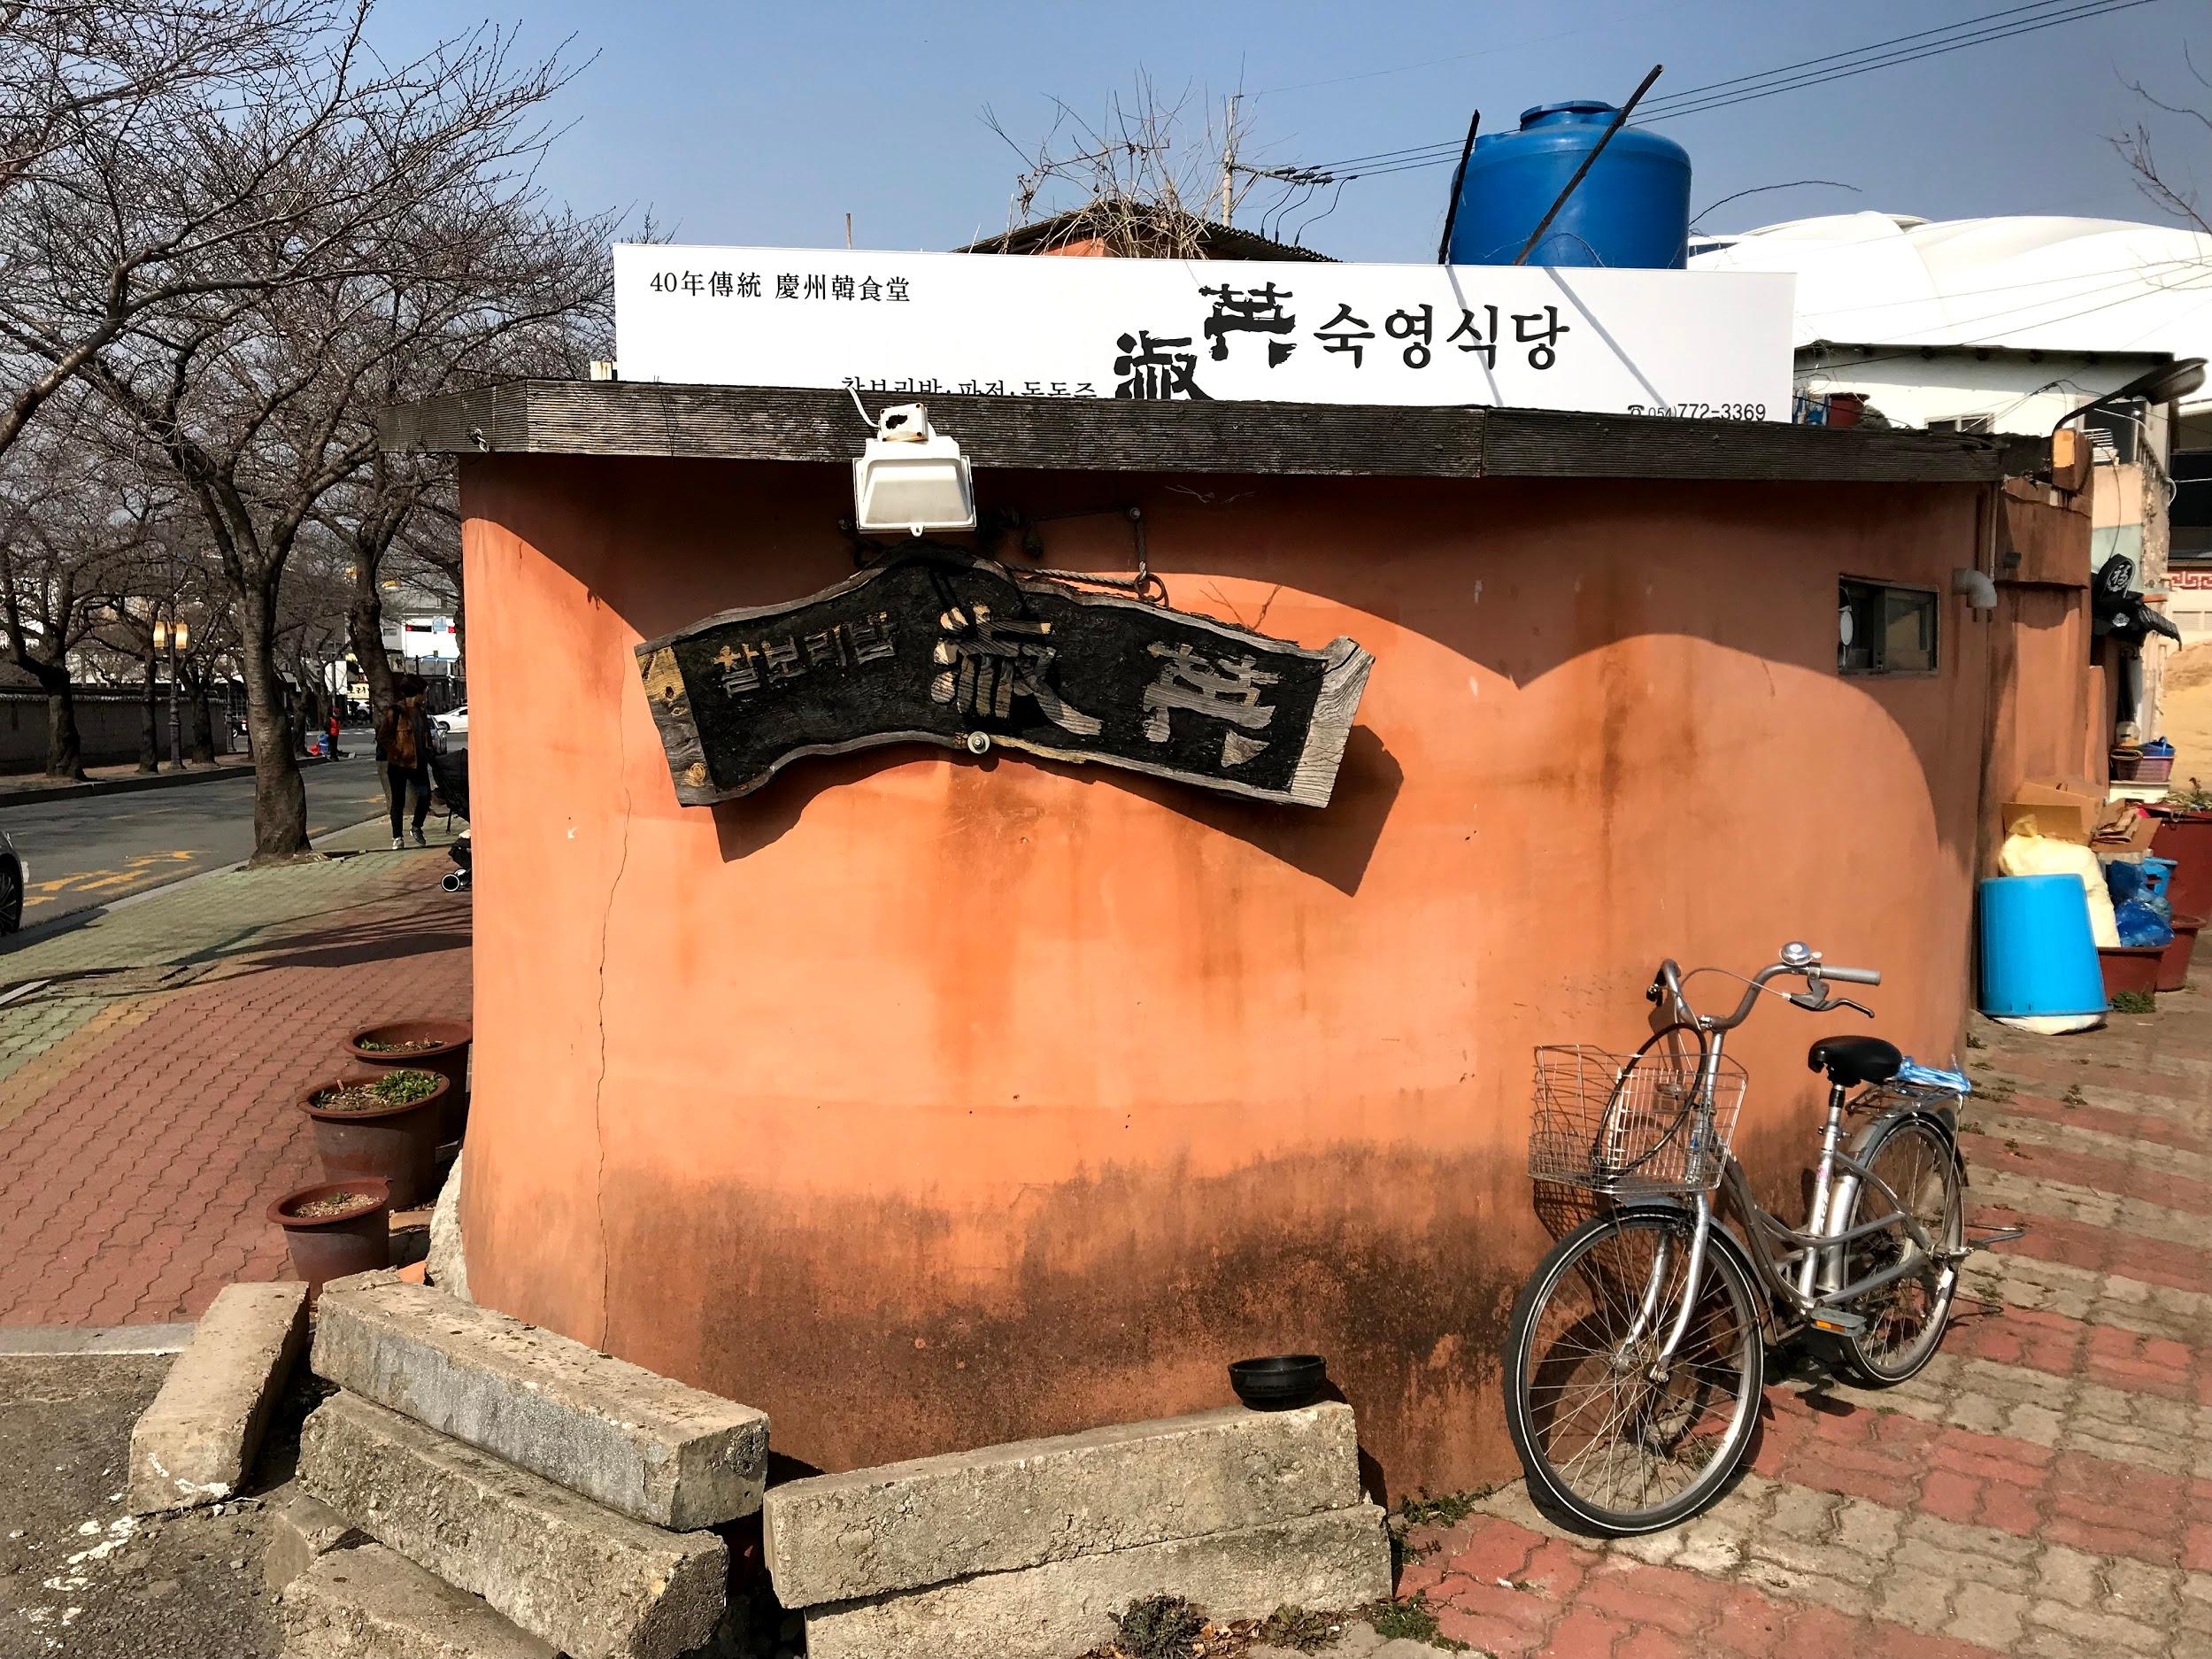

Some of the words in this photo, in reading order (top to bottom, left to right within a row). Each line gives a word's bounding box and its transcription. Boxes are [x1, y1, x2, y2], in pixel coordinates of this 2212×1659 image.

[650, 269, 761, 297] 40年傳統
[775, 273, 910, 302] 慶州韓食堂
[1314, 304, 1570, 370] 숙영식당
